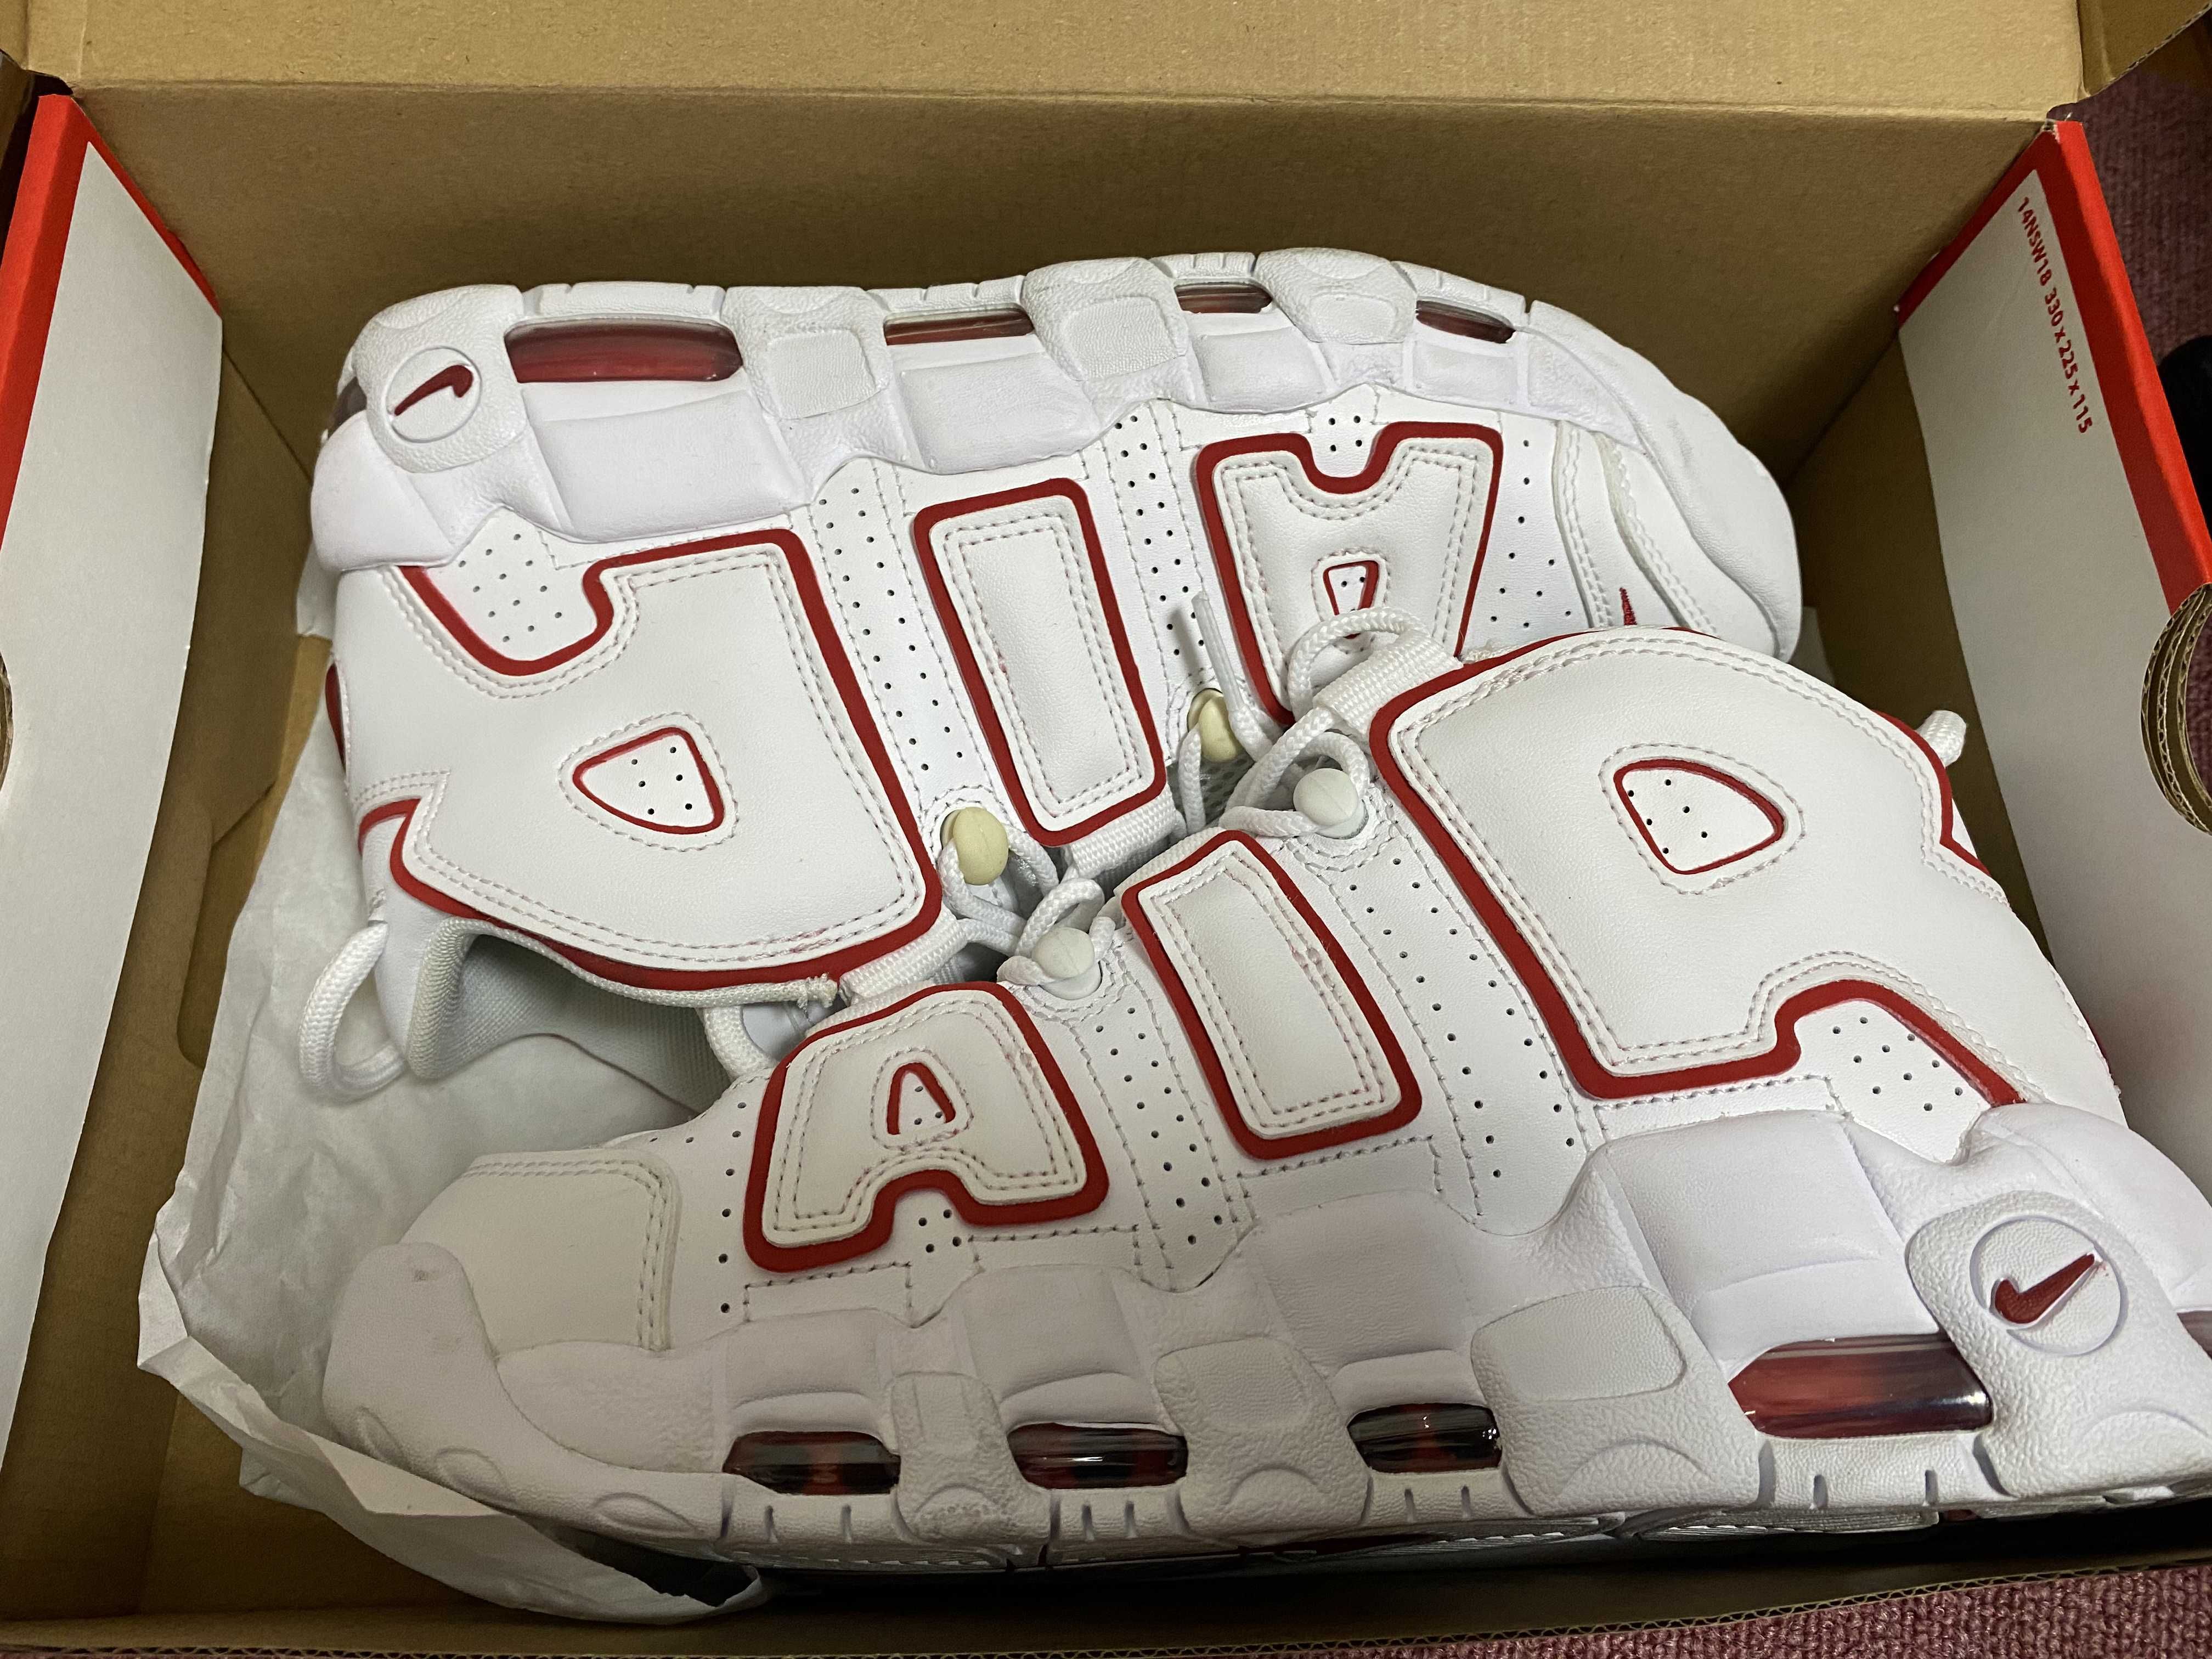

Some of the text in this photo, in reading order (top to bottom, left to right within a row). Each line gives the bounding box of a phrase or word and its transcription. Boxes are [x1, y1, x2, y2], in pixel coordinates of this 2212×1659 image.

[2017, 196, 2052, 286] 14NSW18
[2044, 287, 2064, 327] 330
[2058, 339, 2078, 380] 225
[2072, 394, 2093, 434] 115
